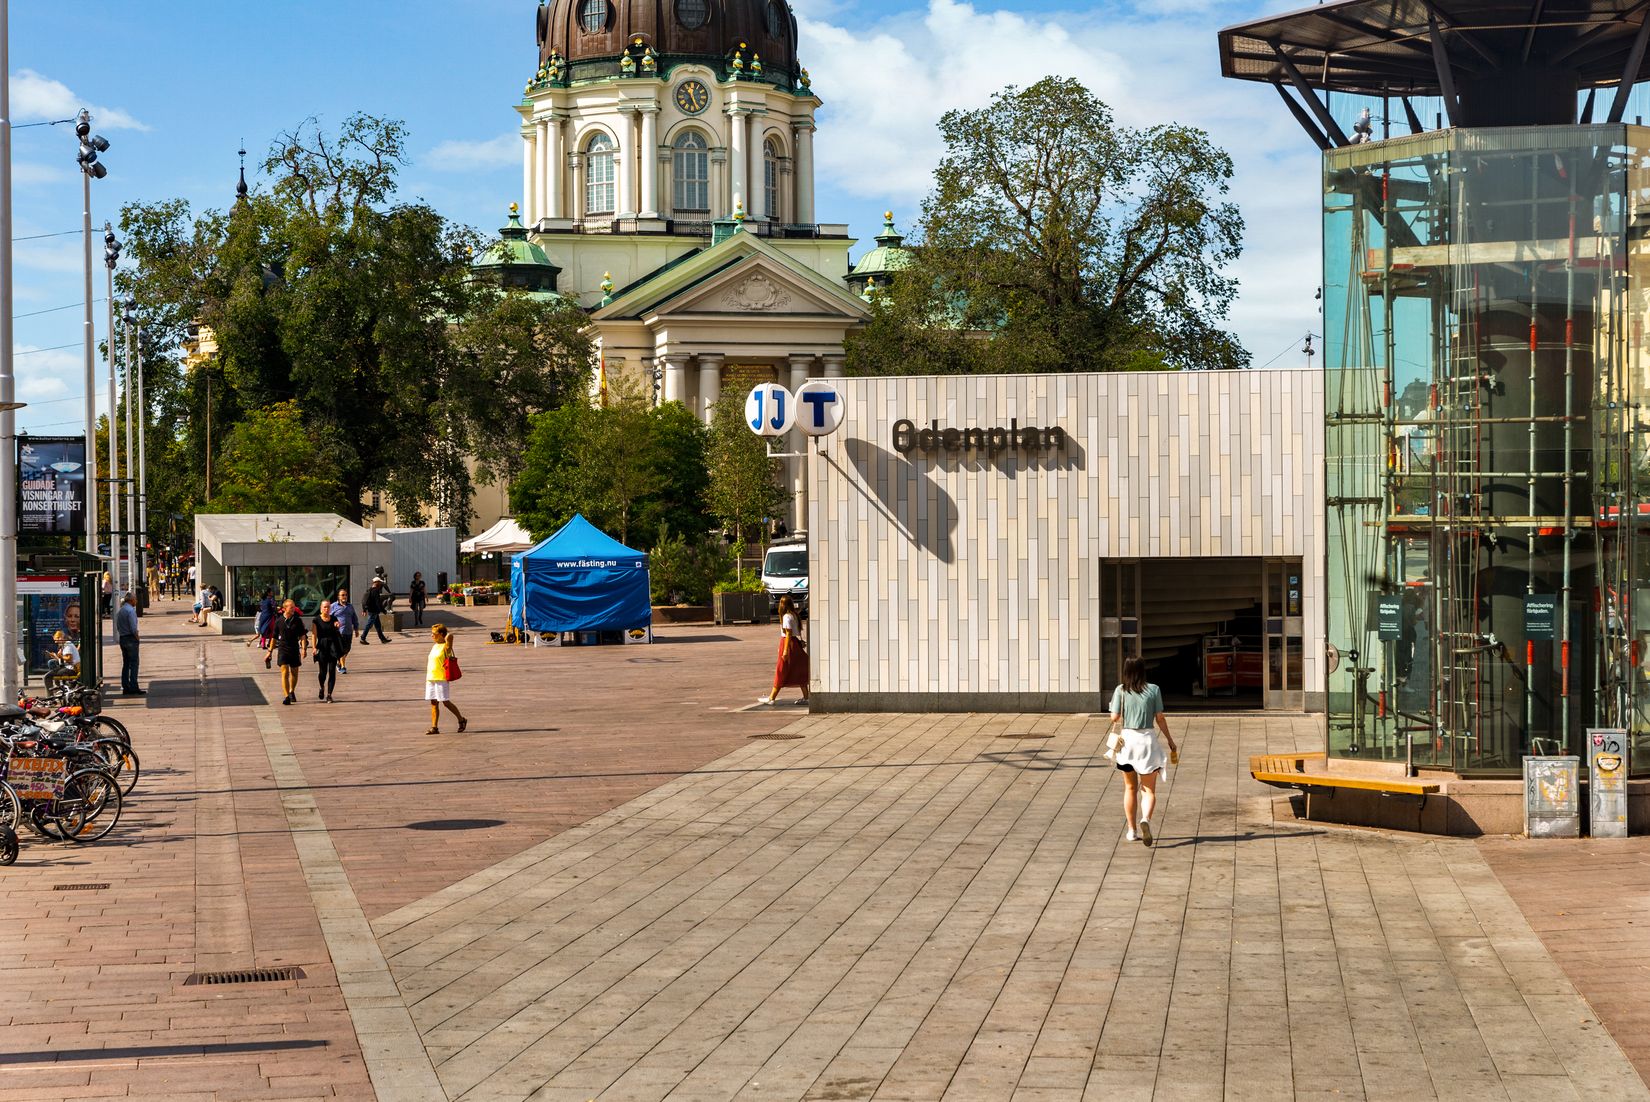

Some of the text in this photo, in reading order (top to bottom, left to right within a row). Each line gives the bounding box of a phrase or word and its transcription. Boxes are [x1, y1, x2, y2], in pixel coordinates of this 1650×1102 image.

[751, 390, 763, 431] J
[770, 390, 785, 430] J
[802, 391, 836, 428] T
[892, 418, 1066, 458] Odenplan
[22, 480, 56, 490] GUIDADE
[22, 490, 75, 501] VISNINGAR AV
[22, 501, 82, 511] KONSERTHUSET
[556, 560, 617, 569] www.fästing.nu
[70, 577, 78, 586] F
